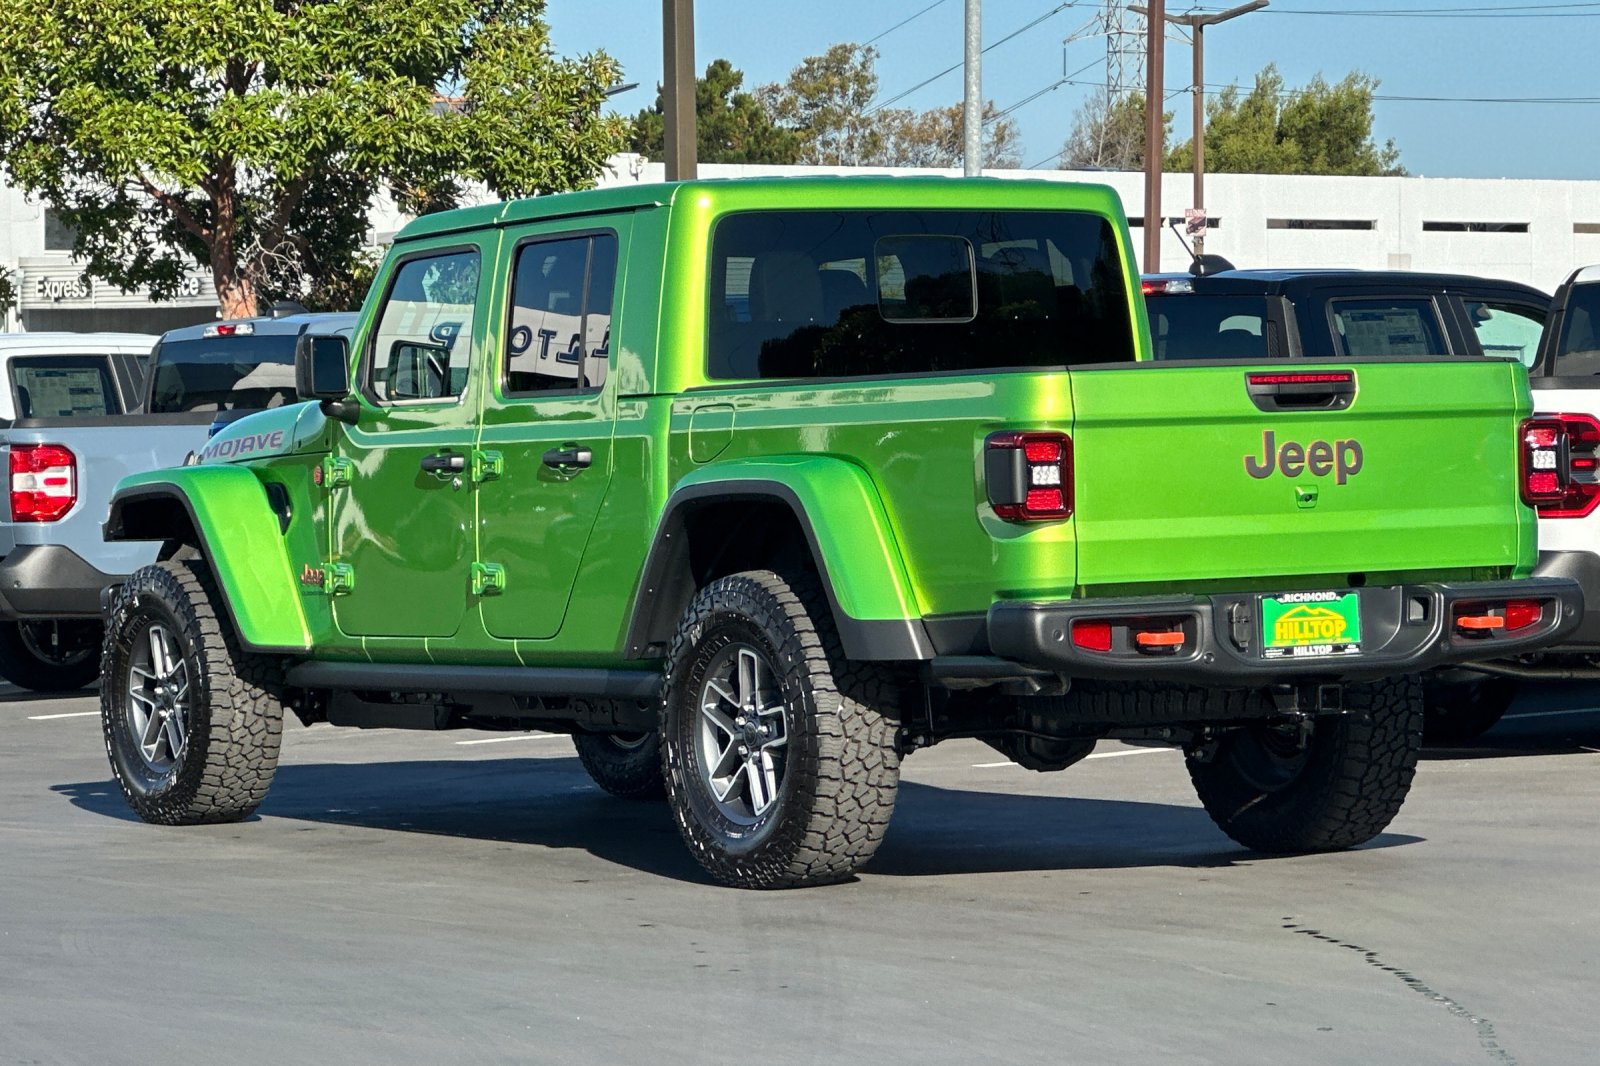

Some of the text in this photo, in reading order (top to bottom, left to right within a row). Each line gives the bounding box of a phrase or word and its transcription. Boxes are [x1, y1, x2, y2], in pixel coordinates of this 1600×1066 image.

[35, 275, 88, 302] Express
[203, 431, 284, 460] MOJAVE
[1243, 429, 1364, 486] Jeep
[1283, 591, 1337, 603] RICHMOND
[1275, 618, 1347, 641] HILLTOP
[1293, 644, 1333, 657] HILLTOP
